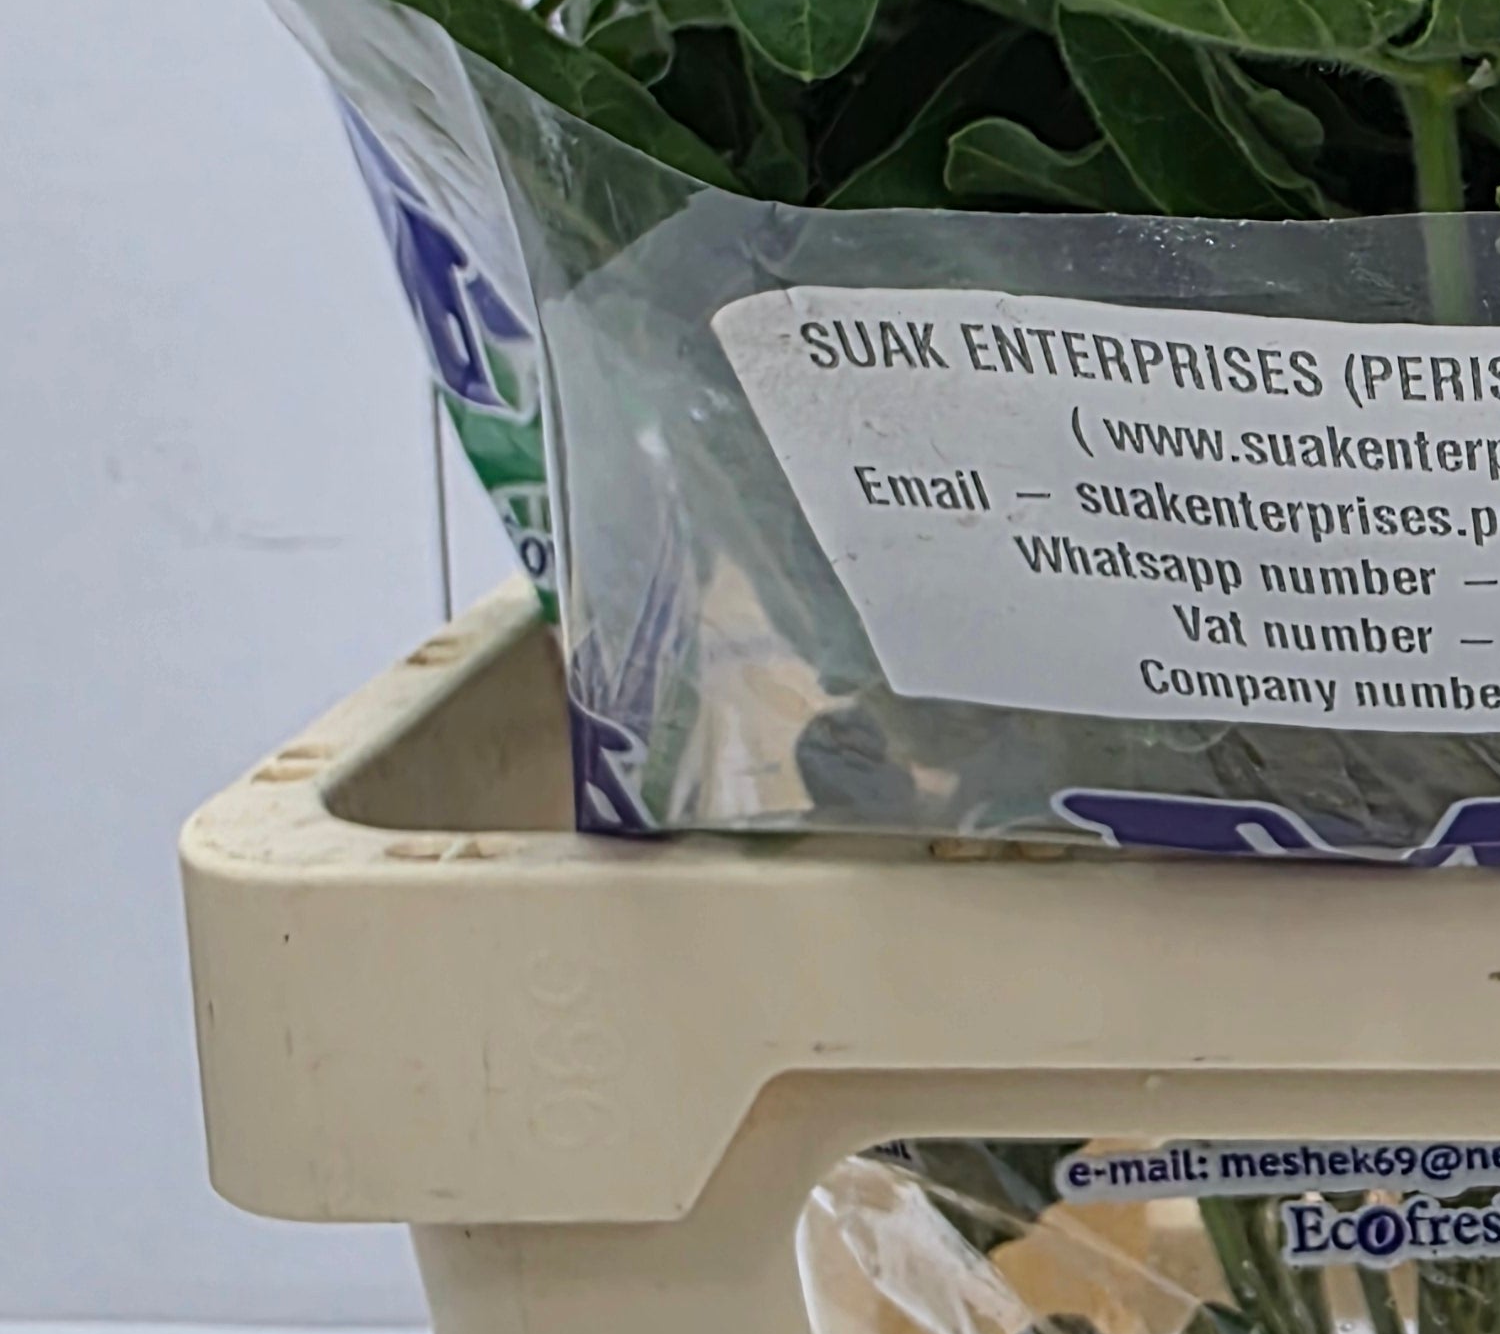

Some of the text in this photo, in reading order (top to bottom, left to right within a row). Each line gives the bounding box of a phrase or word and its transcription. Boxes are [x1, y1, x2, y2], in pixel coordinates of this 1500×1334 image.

[800, 320, 949, 369] SUAK
[960, 323, 1323, 398] ENTERPRISES
[853, 466, 991, 511] Email
[1013, 534, 1243, 595] Whatsapp
[1260, 557, 1435, 598] number
[1172, 604, 1246, 648] Vat
[1263, 613, 1433, 654] number
[1140, 658, 1337, 712] Company
[1067, 1149, 1210, 1187] e-mail:
